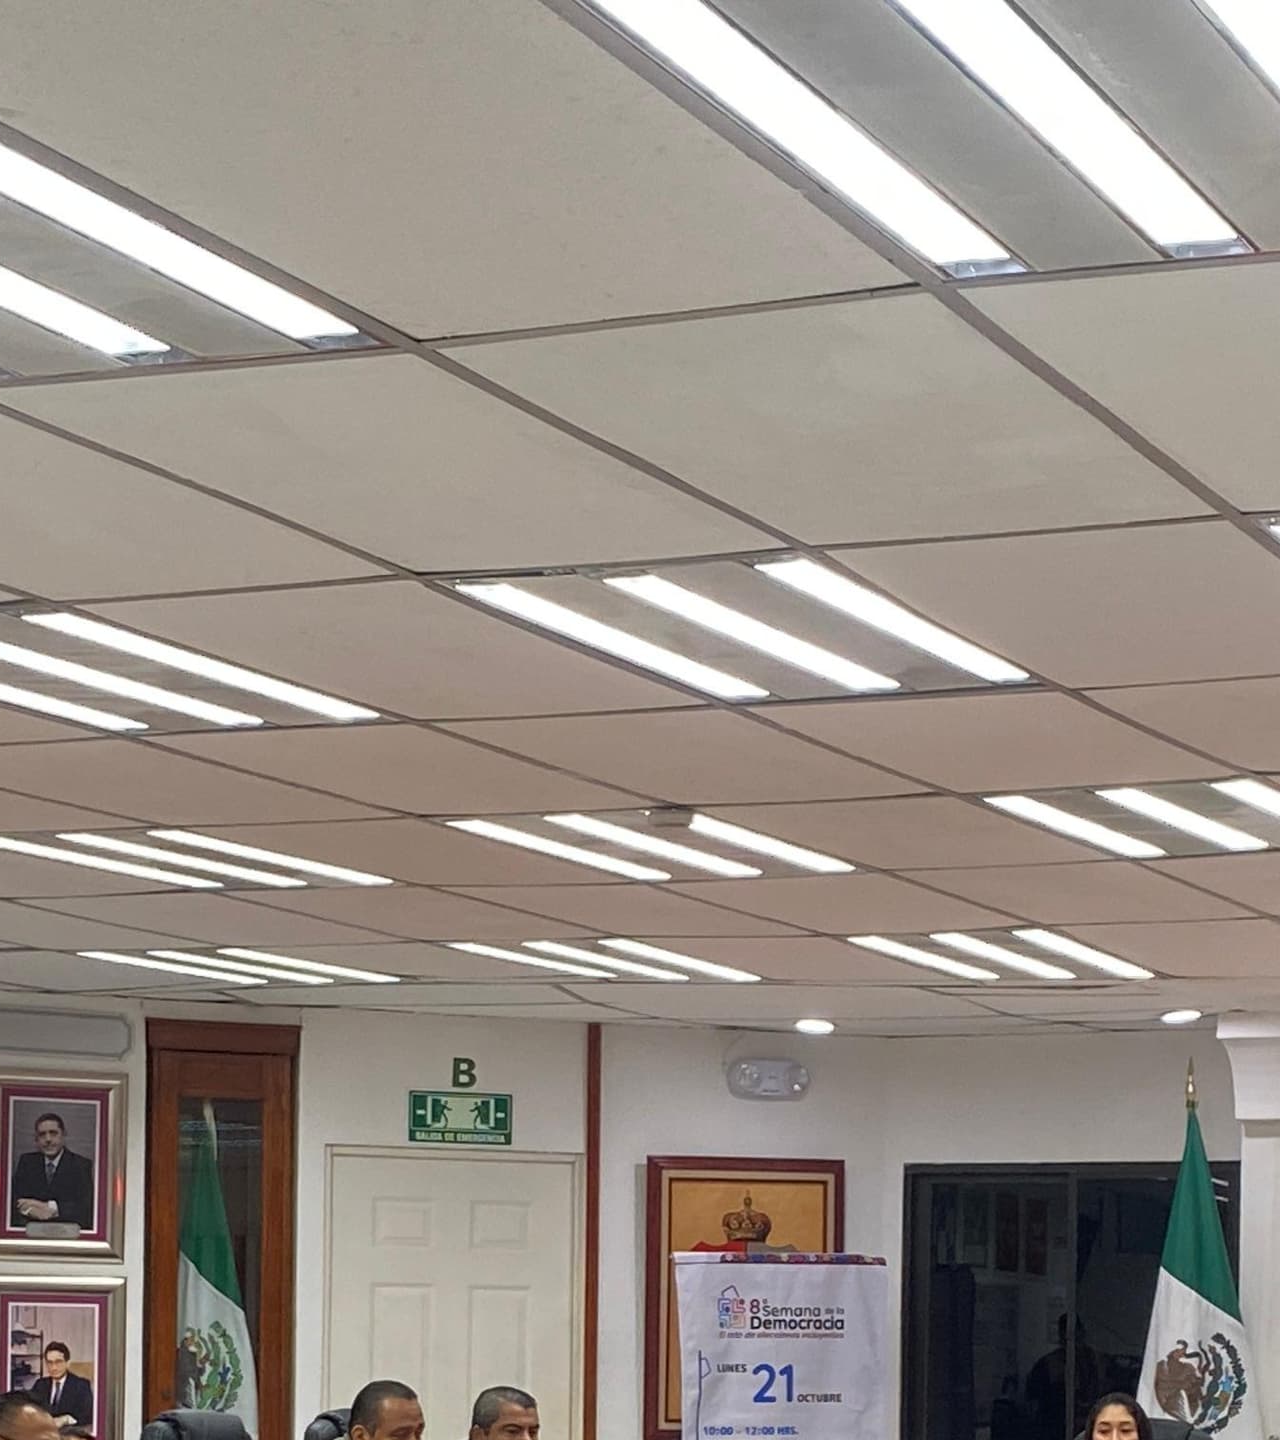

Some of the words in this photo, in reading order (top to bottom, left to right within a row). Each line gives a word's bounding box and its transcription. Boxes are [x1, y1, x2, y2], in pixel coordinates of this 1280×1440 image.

[452, 1057, 478, 1088] B
[762, 1305, 821, 1318] Semana
[750, 1315, 845, 1331] Democracia
[717, 1363, 748, 1374] LUNES
[752, 1363, 794, 1404] 21
[797, 1393, 843, 1404] OCTUBRE
